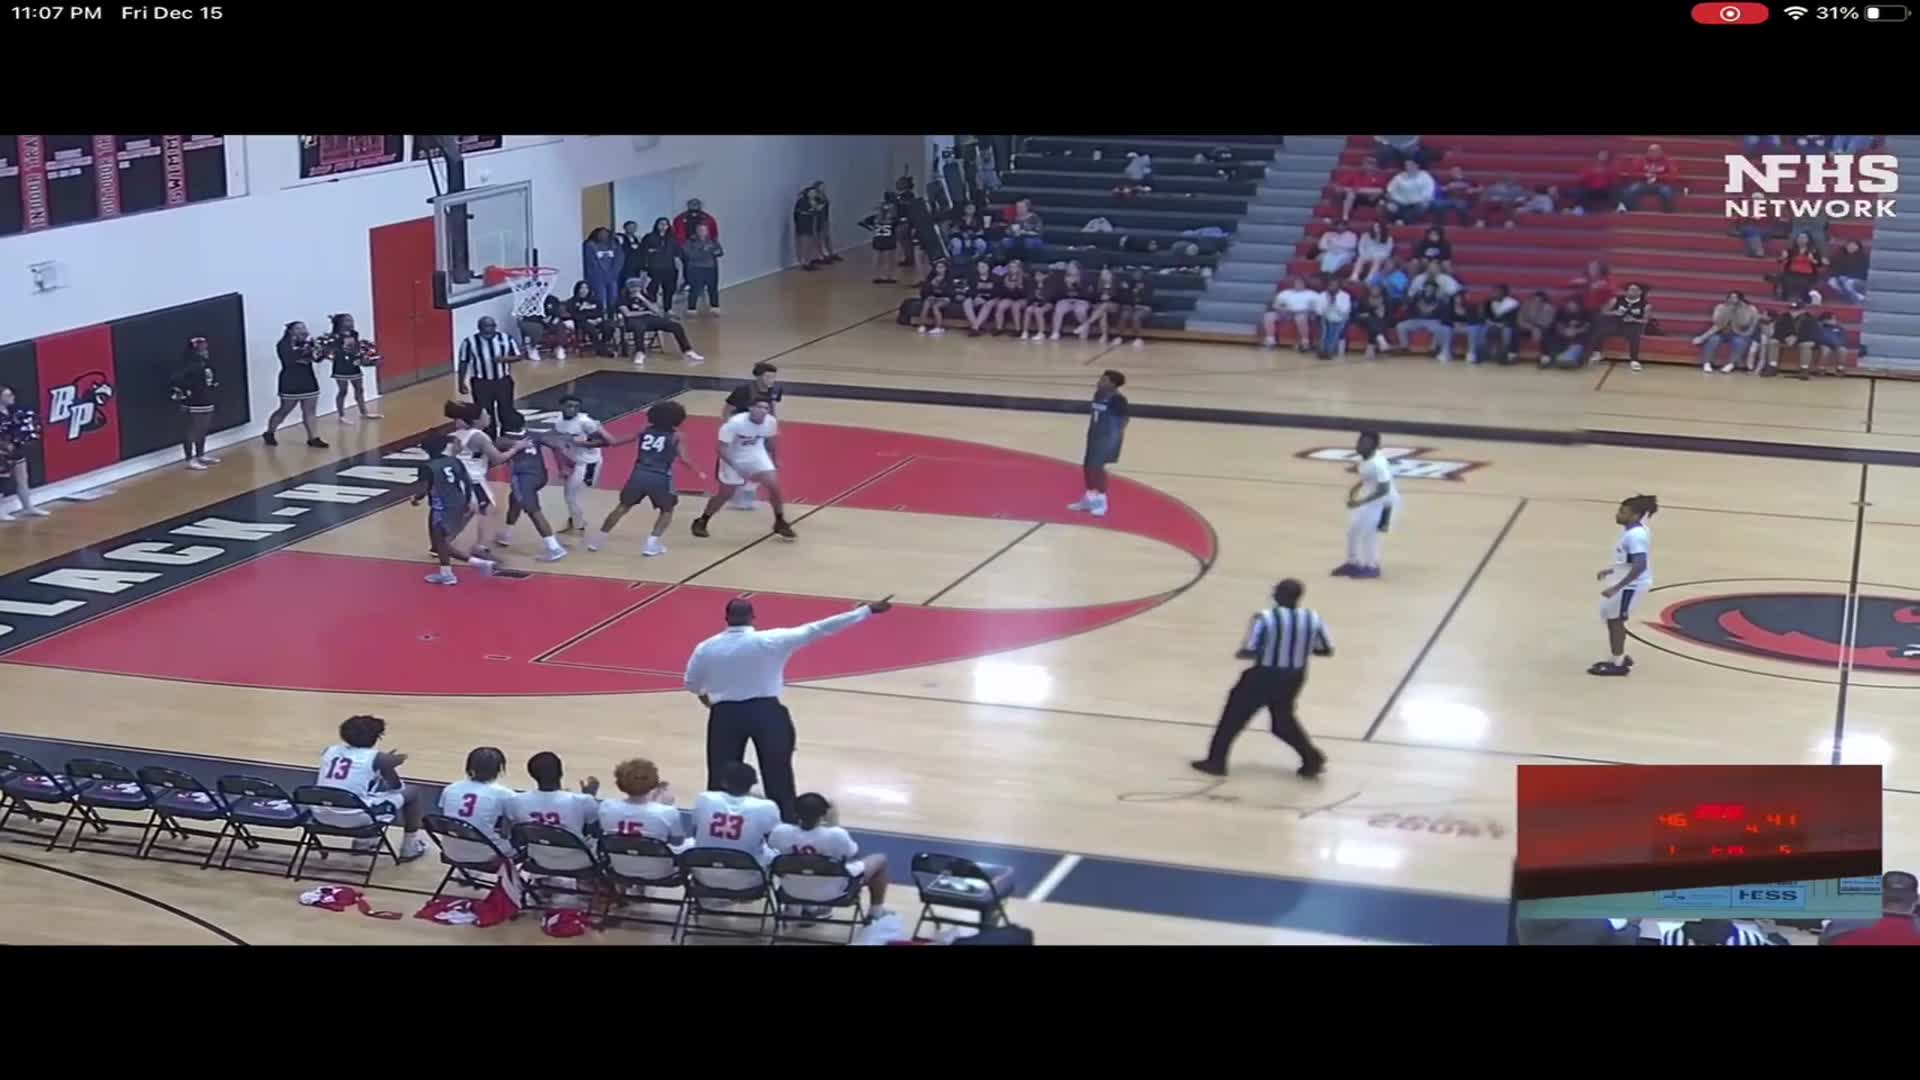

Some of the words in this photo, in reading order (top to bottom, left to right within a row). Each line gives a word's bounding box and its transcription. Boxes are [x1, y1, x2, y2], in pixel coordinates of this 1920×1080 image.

[49, 385, 96, 441] BP
[641, 433, 665, 452] 24
[443, 466, 456, 483] 5
[325, 756, 353, 780] 13
[458, 793, 476, 817] 3
[709, 812, 744, 840] 23
